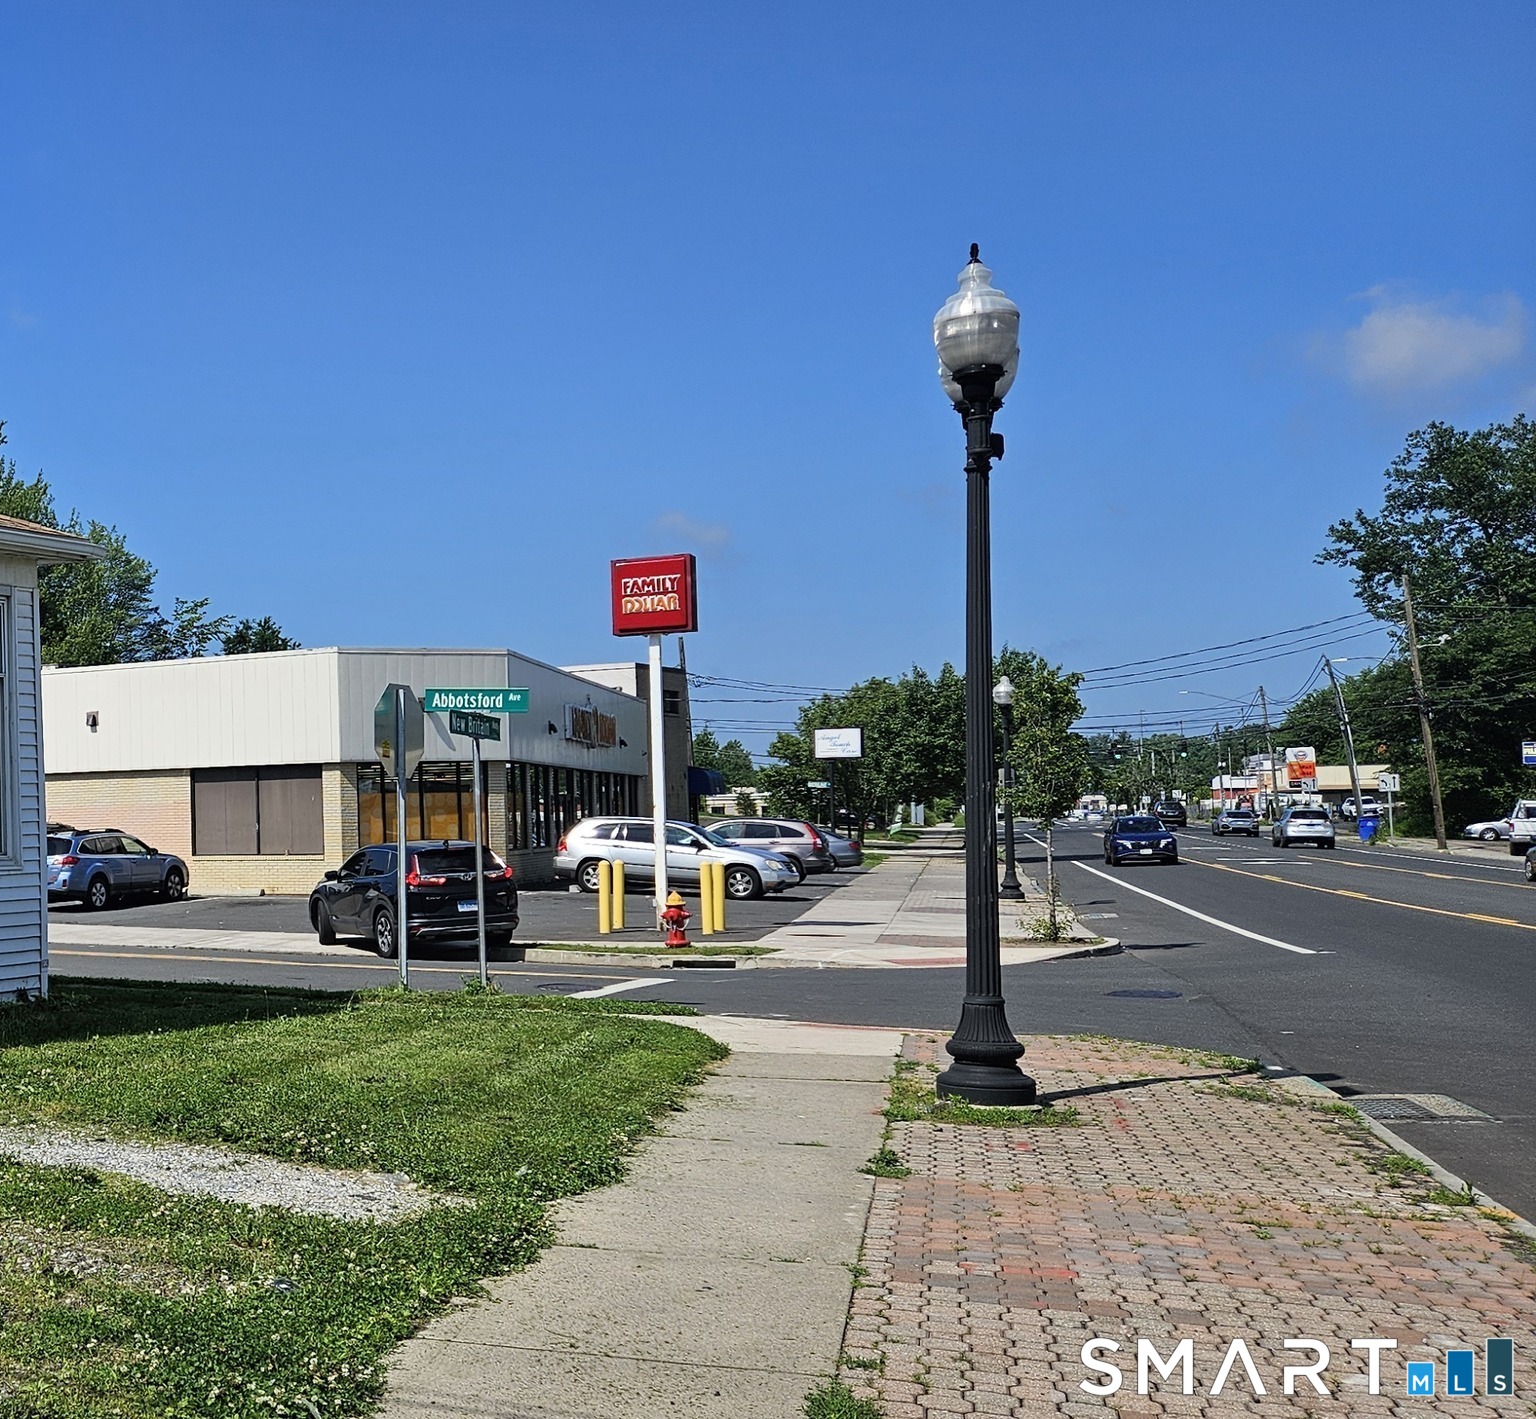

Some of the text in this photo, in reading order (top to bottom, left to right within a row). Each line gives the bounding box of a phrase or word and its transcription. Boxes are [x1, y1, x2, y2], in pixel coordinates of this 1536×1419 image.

[622, 574, 681, 595] FAMILY
[622, 593, 681, 614] DOLLAR
[432, 692, 521, 708] Abbotsford Ave
[452, 712, 466, 731] New
[468, 715, 491, 736] Britain
